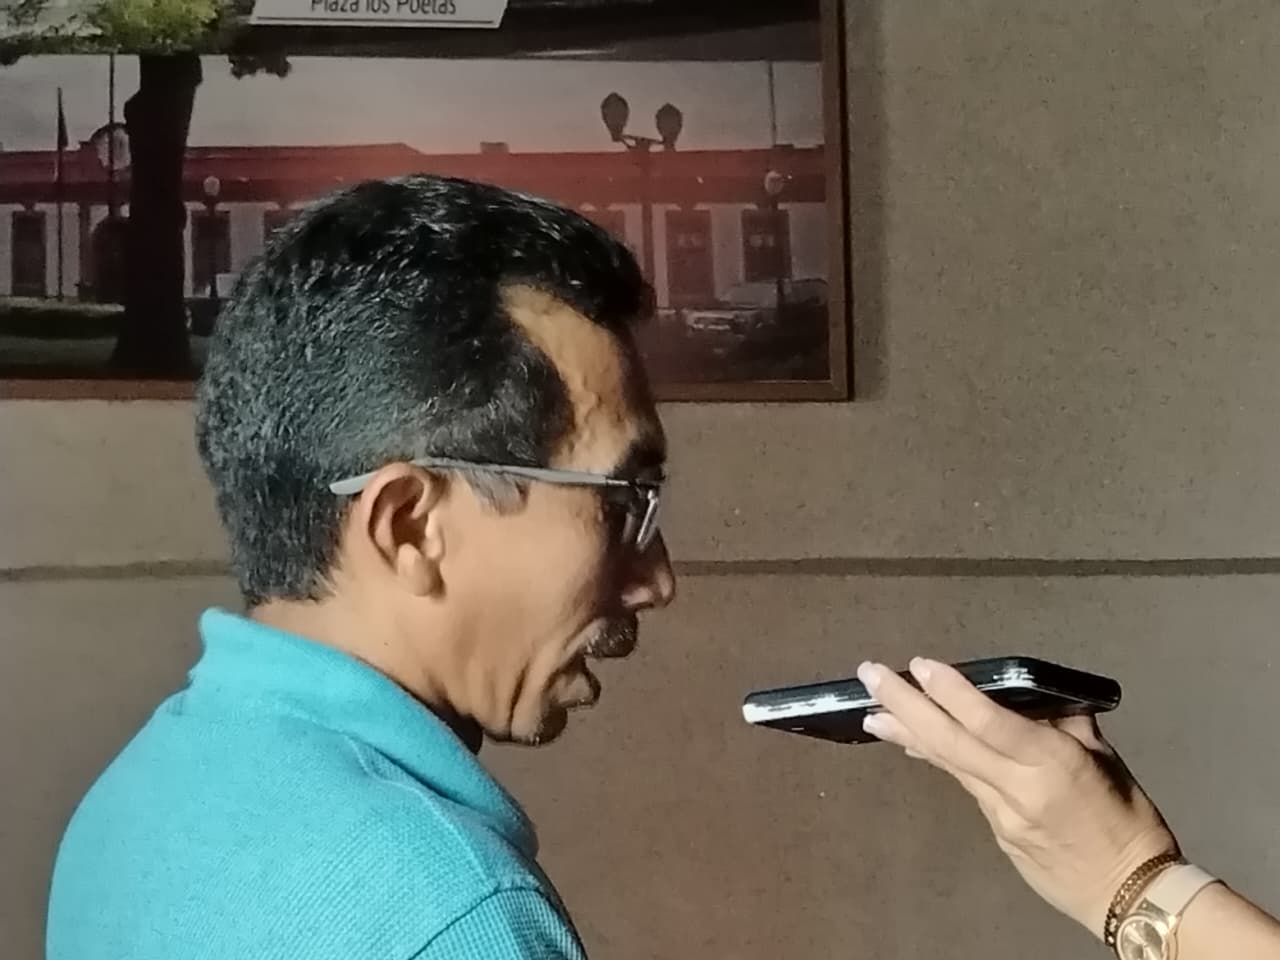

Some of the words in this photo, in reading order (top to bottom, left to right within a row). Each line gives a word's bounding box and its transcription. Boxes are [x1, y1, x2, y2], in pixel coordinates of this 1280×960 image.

[311, 0, 359, 13] Plaza
[365, 0, 390, 14] los
[396, 0, 457, 15] Poetas
